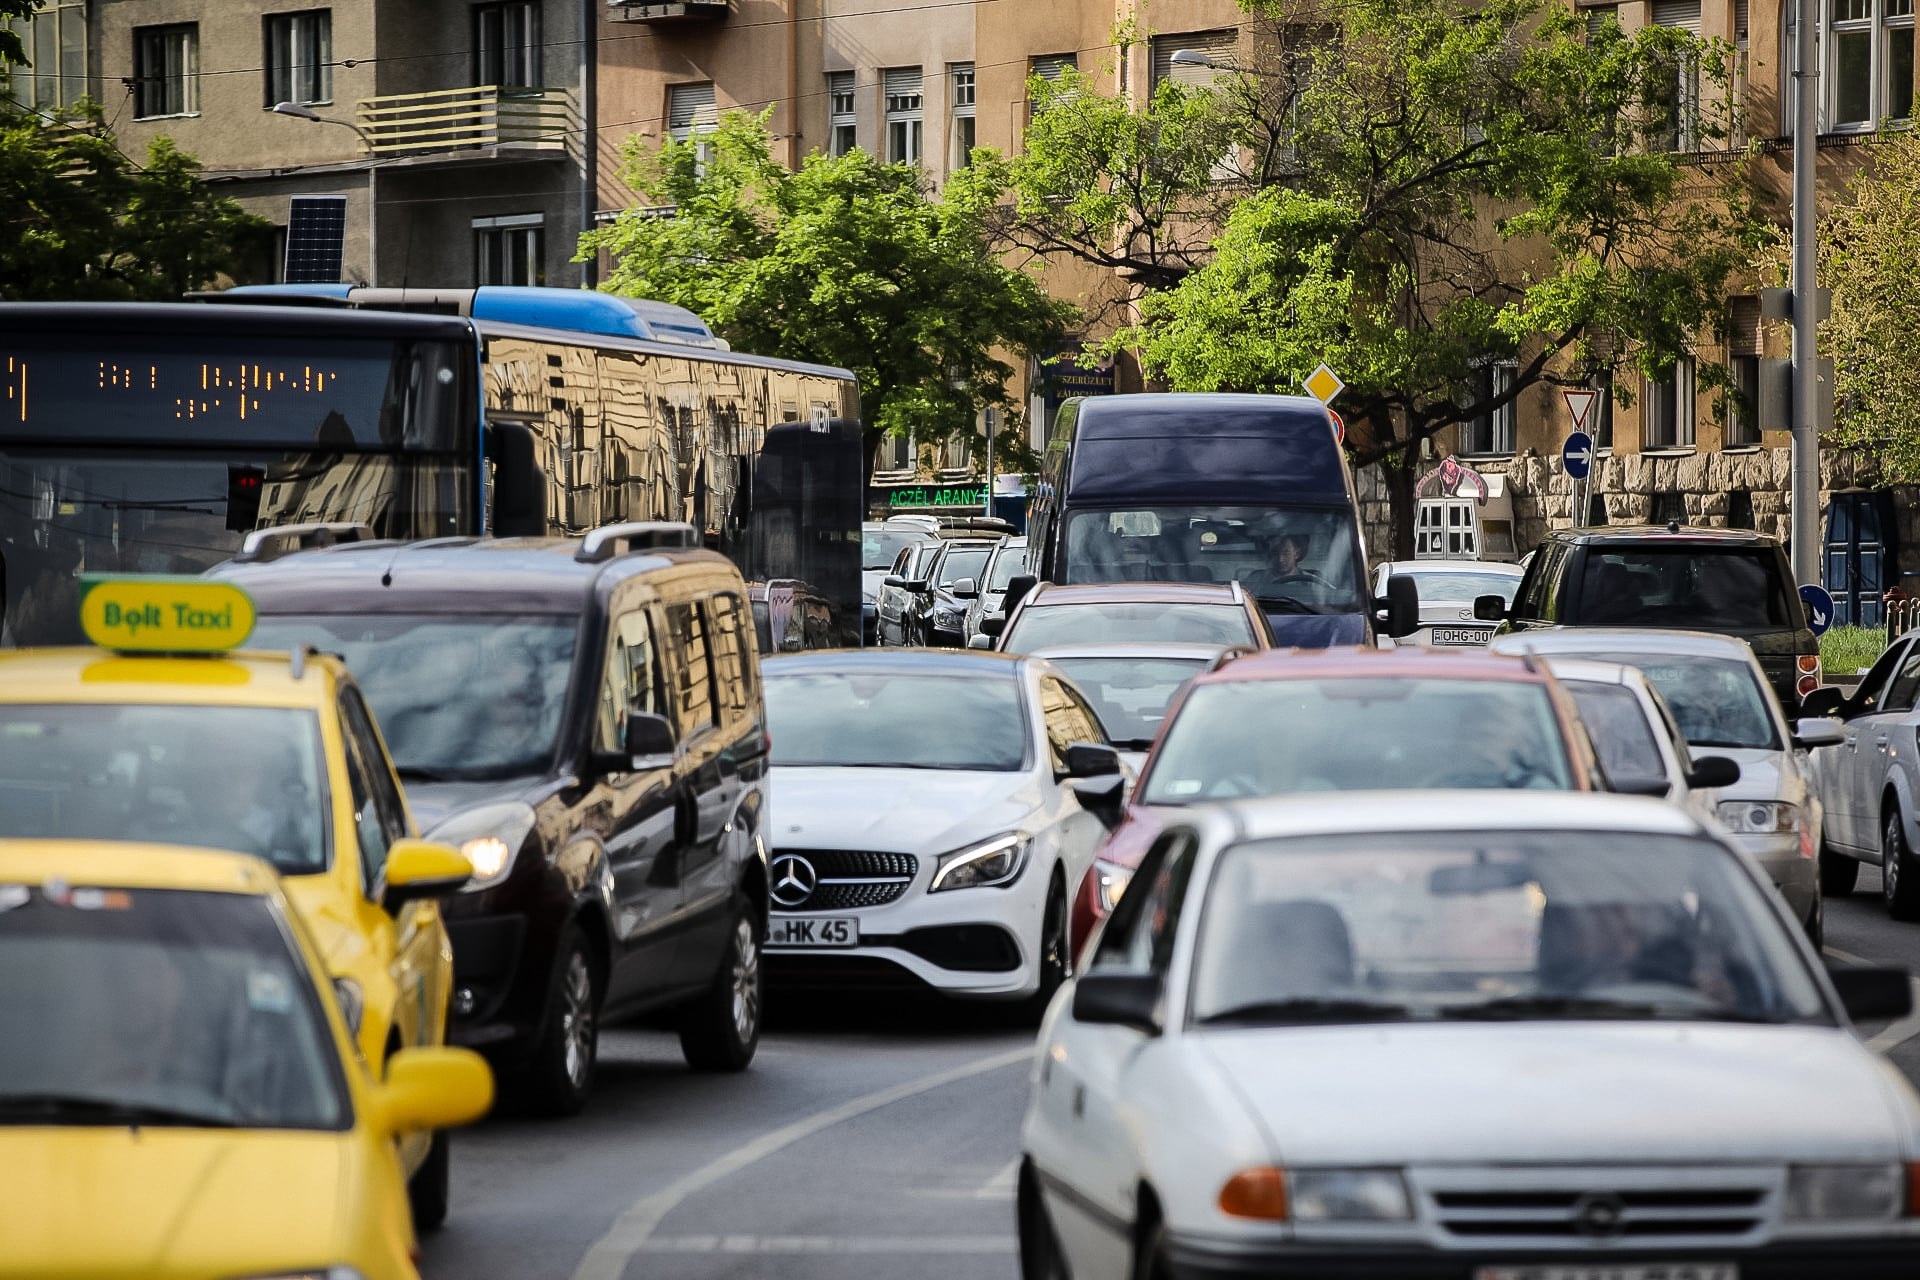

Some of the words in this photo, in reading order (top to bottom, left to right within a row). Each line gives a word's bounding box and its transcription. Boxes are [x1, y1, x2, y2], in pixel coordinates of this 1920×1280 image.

[1052, 374, 1112, 386] SZERÜZLET
[889, 486, 930, 506] ACZÉL
[934, 488, 978, 505] ARANY
[104, 601, 161, 637] Bolt
[171, 602, 232, 630] Taxi
[785, 920, 815, 943] HK
[820, 920, 849, 942] 45
